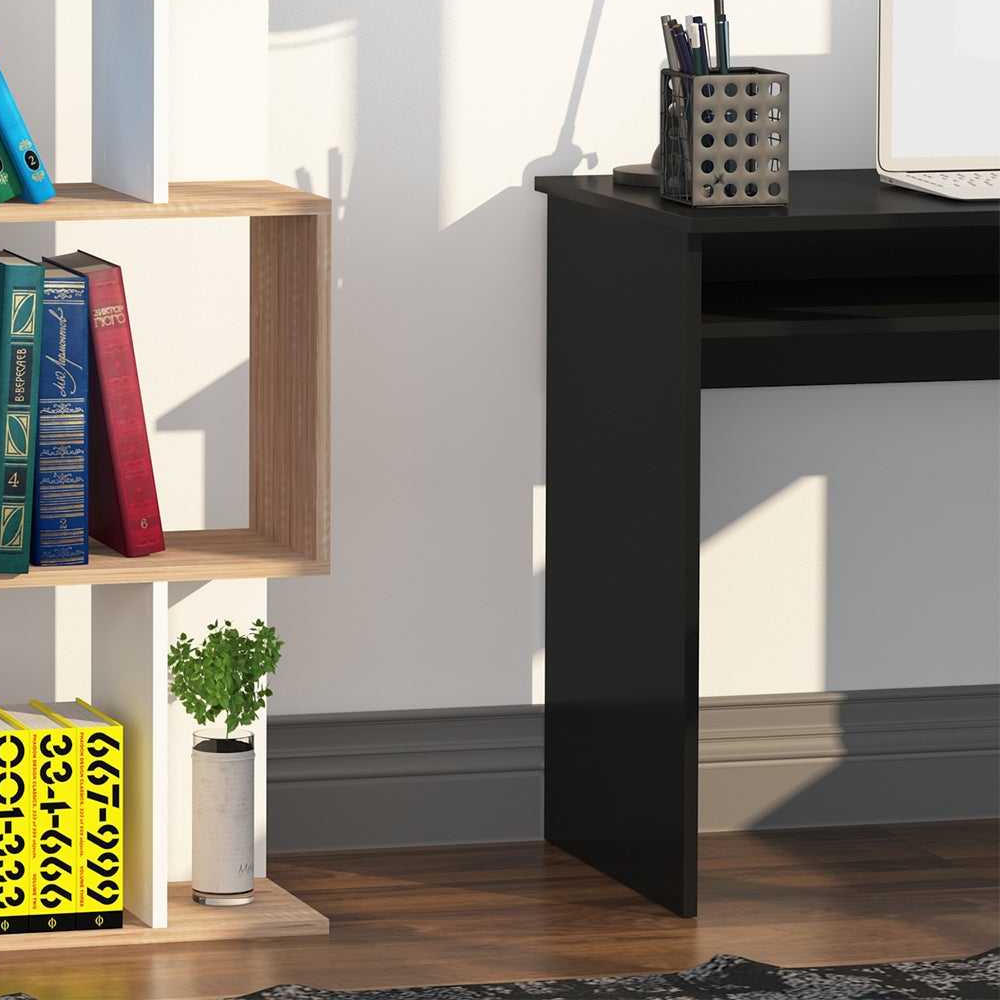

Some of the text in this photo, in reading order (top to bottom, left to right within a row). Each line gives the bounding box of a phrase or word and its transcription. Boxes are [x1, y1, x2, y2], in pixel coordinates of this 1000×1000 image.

[28, 155, 36, 166] 2
[94, 313, 125, 328] ГЮГО
[7, 473, 19, 488] 4
[59, 518, 67, 528] 2
[140, 518, 148, 529] 6
[40, 734, 73, 908] 334-666
[87, 732, 120, 906] 667-999
